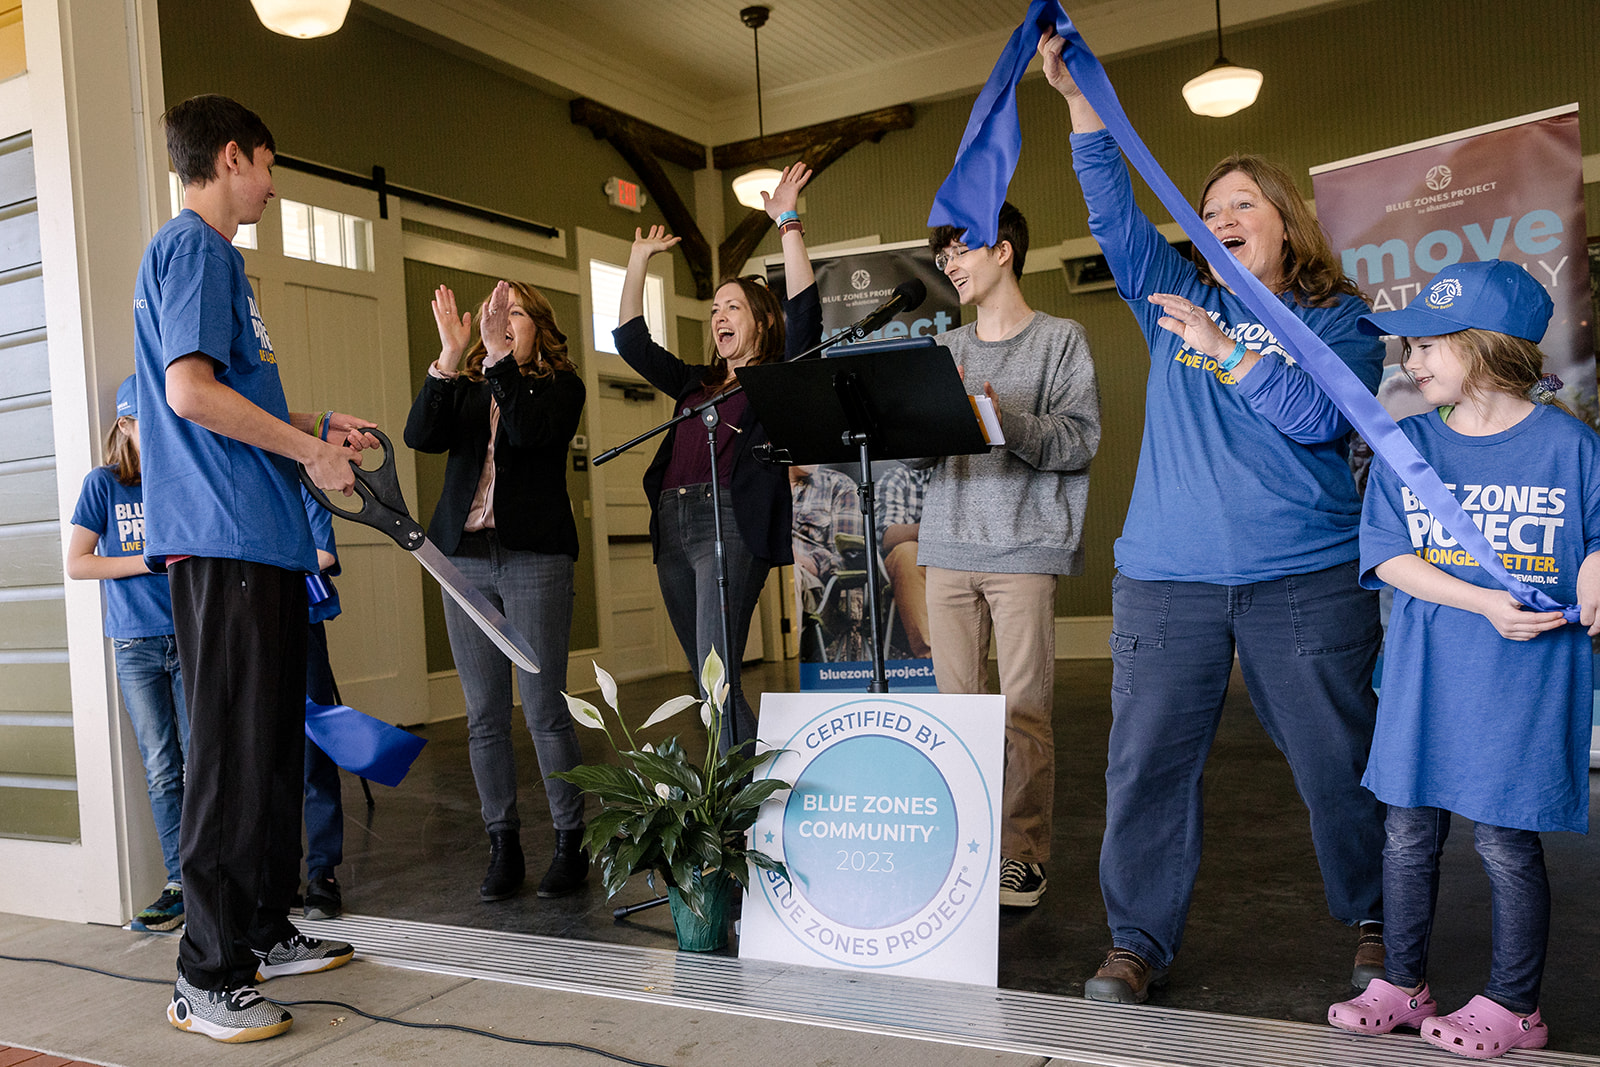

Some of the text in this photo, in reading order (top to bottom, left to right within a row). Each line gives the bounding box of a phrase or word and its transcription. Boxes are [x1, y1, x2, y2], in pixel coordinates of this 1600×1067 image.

[618, 179, 637, 208] EXIT
[1385, 181, 1497, 213] BLUE ZONES PROJECT
[1426, 199, 1465, 213] sharecare
[1341, 209, 1563, 285] move
[822, 287, 896, 304] BLUE ZONES PROJE
[1175, 349, 1201, 369] LIVE
[1461, 484, 1566, 516] ZONES
[121, 541, 142, 552] LIVE
[1423, 548, 1480, 567] LONGE
[1496, 553, 1559, 573] ETTER.
[1546, 576, 1558, 584] NC
[805, 710, 946, 752] CERTIFIED BY
[803, 794, 938, 816] BLUE ZONES
[835, 850, 895, 873] 2023
[766, 869, 806, 925] BLUE
[804, 917, 879, 956] ZONES
